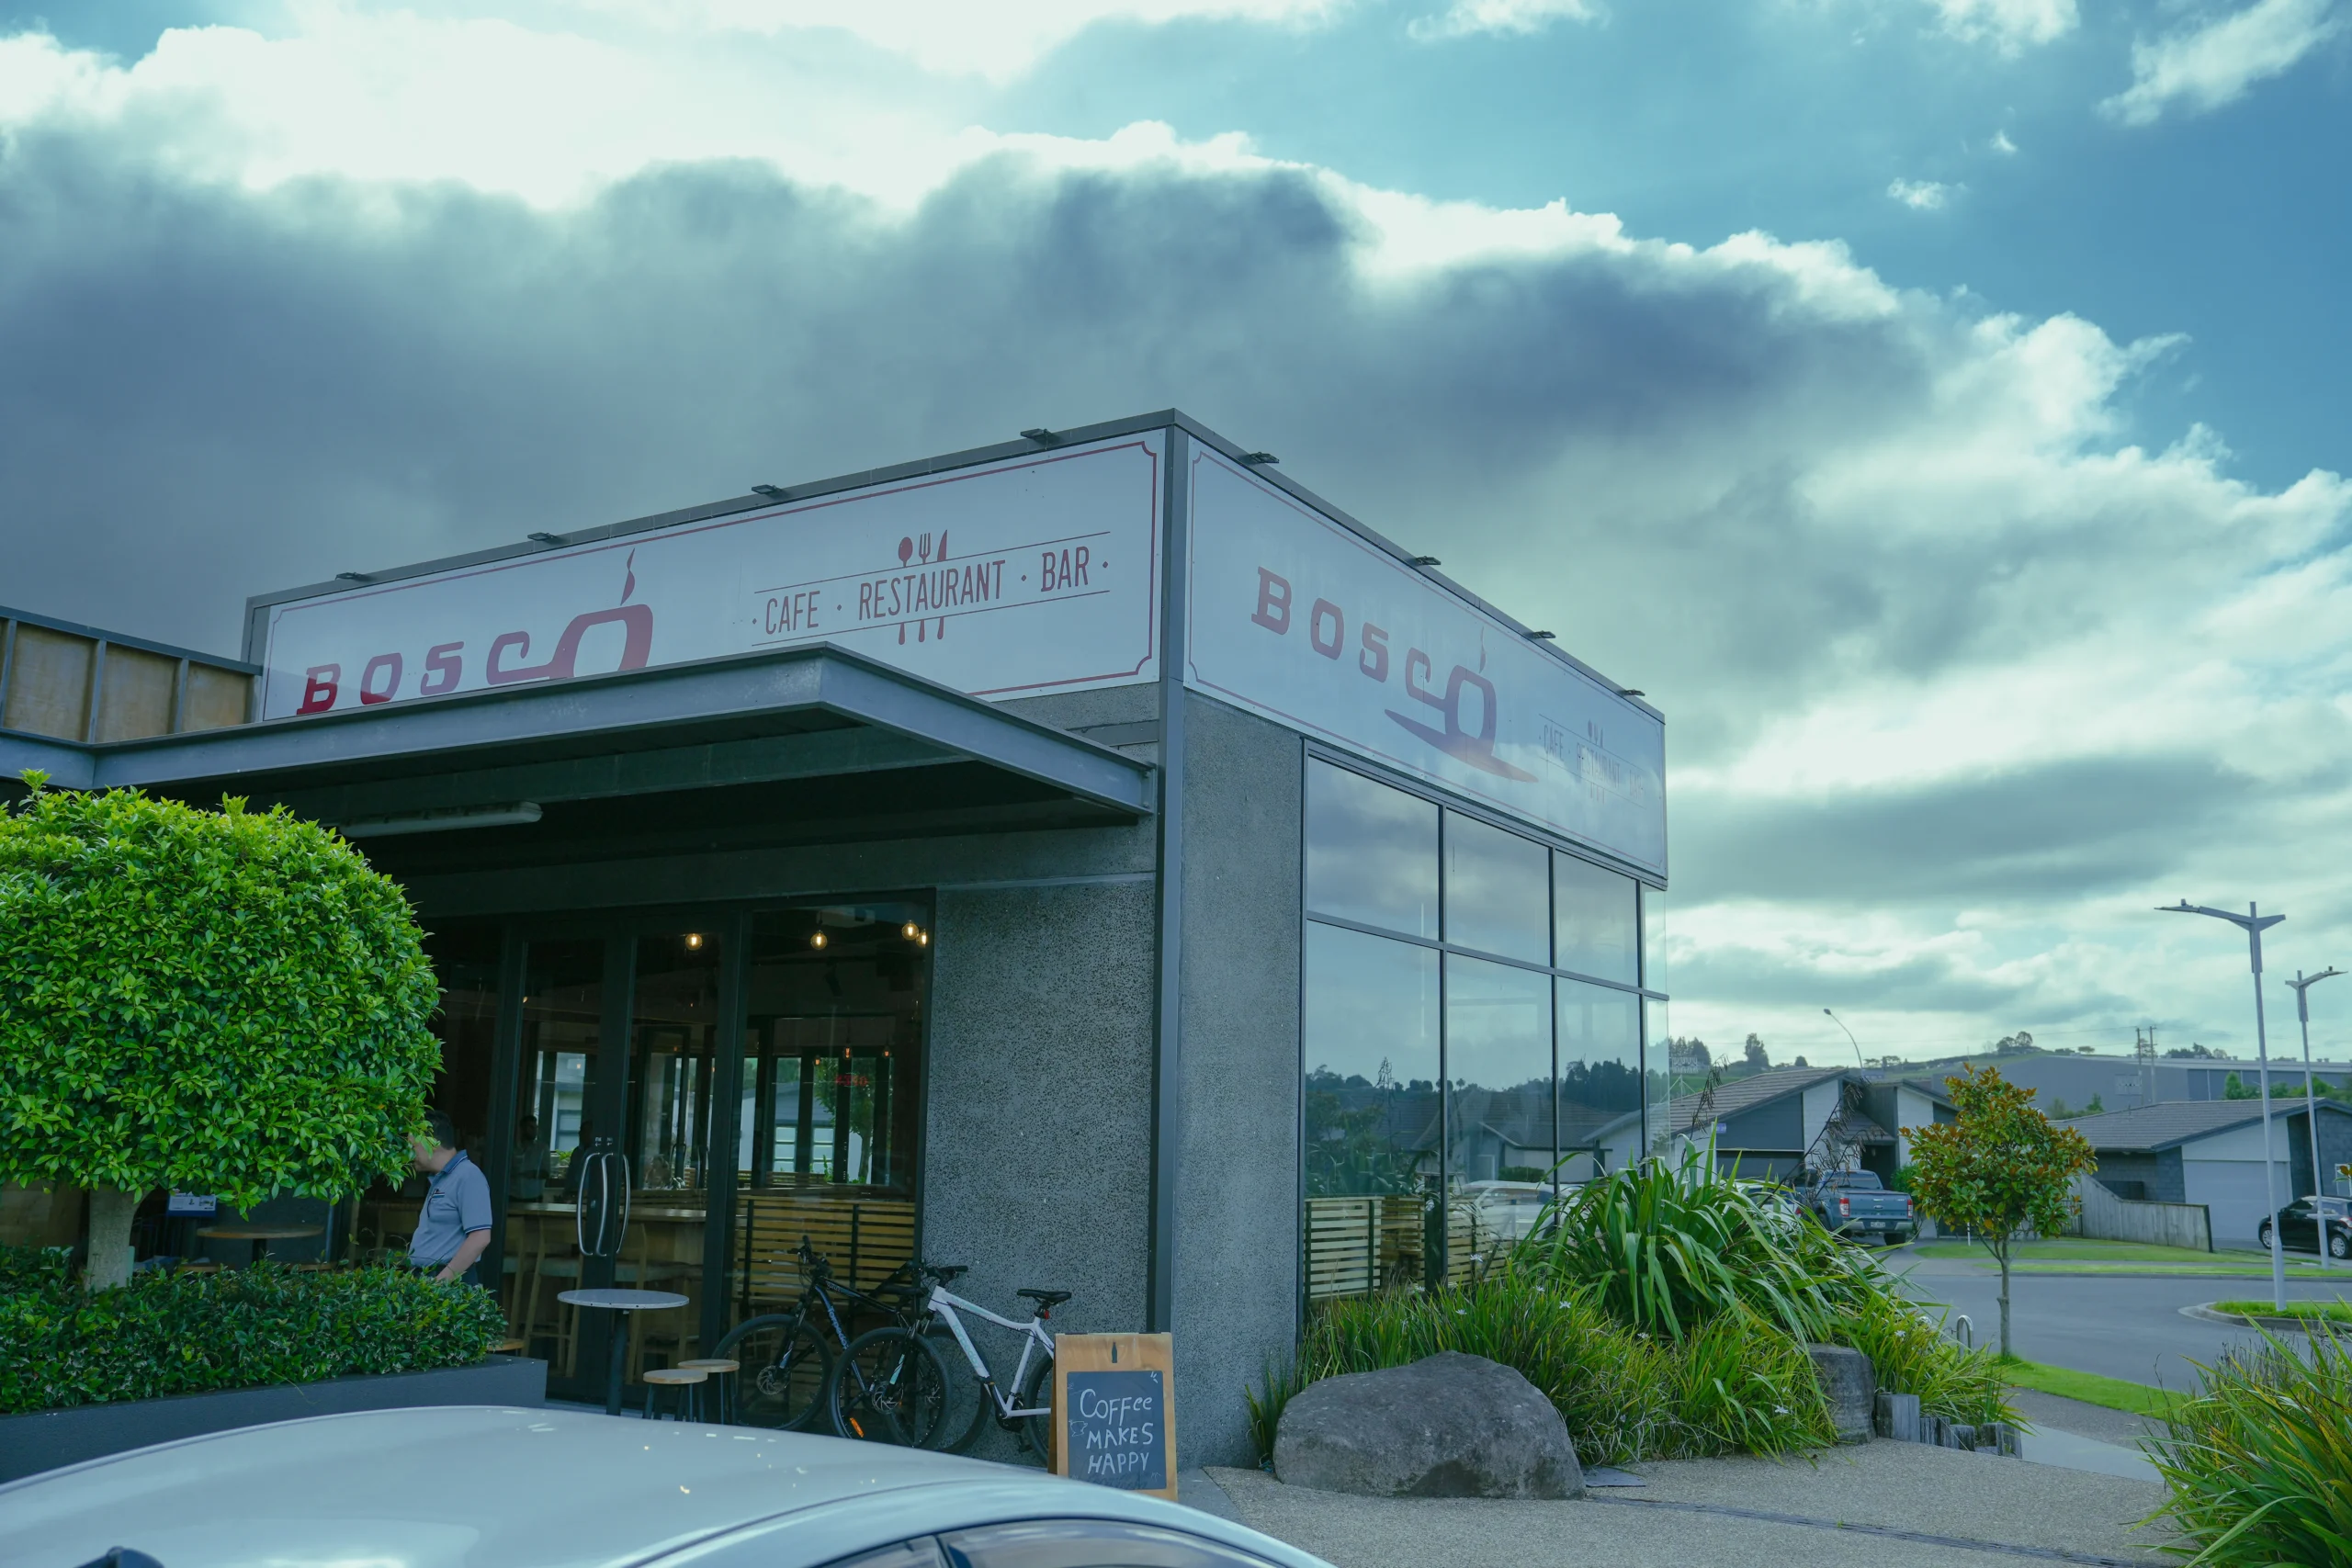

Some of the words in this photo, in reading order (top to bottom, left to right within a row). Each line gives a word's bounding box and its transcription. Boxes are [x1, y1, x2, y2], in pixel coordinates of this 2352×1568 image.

[765, 591, 820, 635] CAFE
[859, 559, 1005, 621] RESTAURANT
[1041, 546, 1090, 592] BAR
[297, 604, 653, 715] BOSCO
[1251, 566, 1497, 756] BOSCO
[1544, 724, 1564, 761] CAFE
[1086, 1423, 1154, 1449] MAKES
[1088, 1451, 1149, 1474] HAPPY
